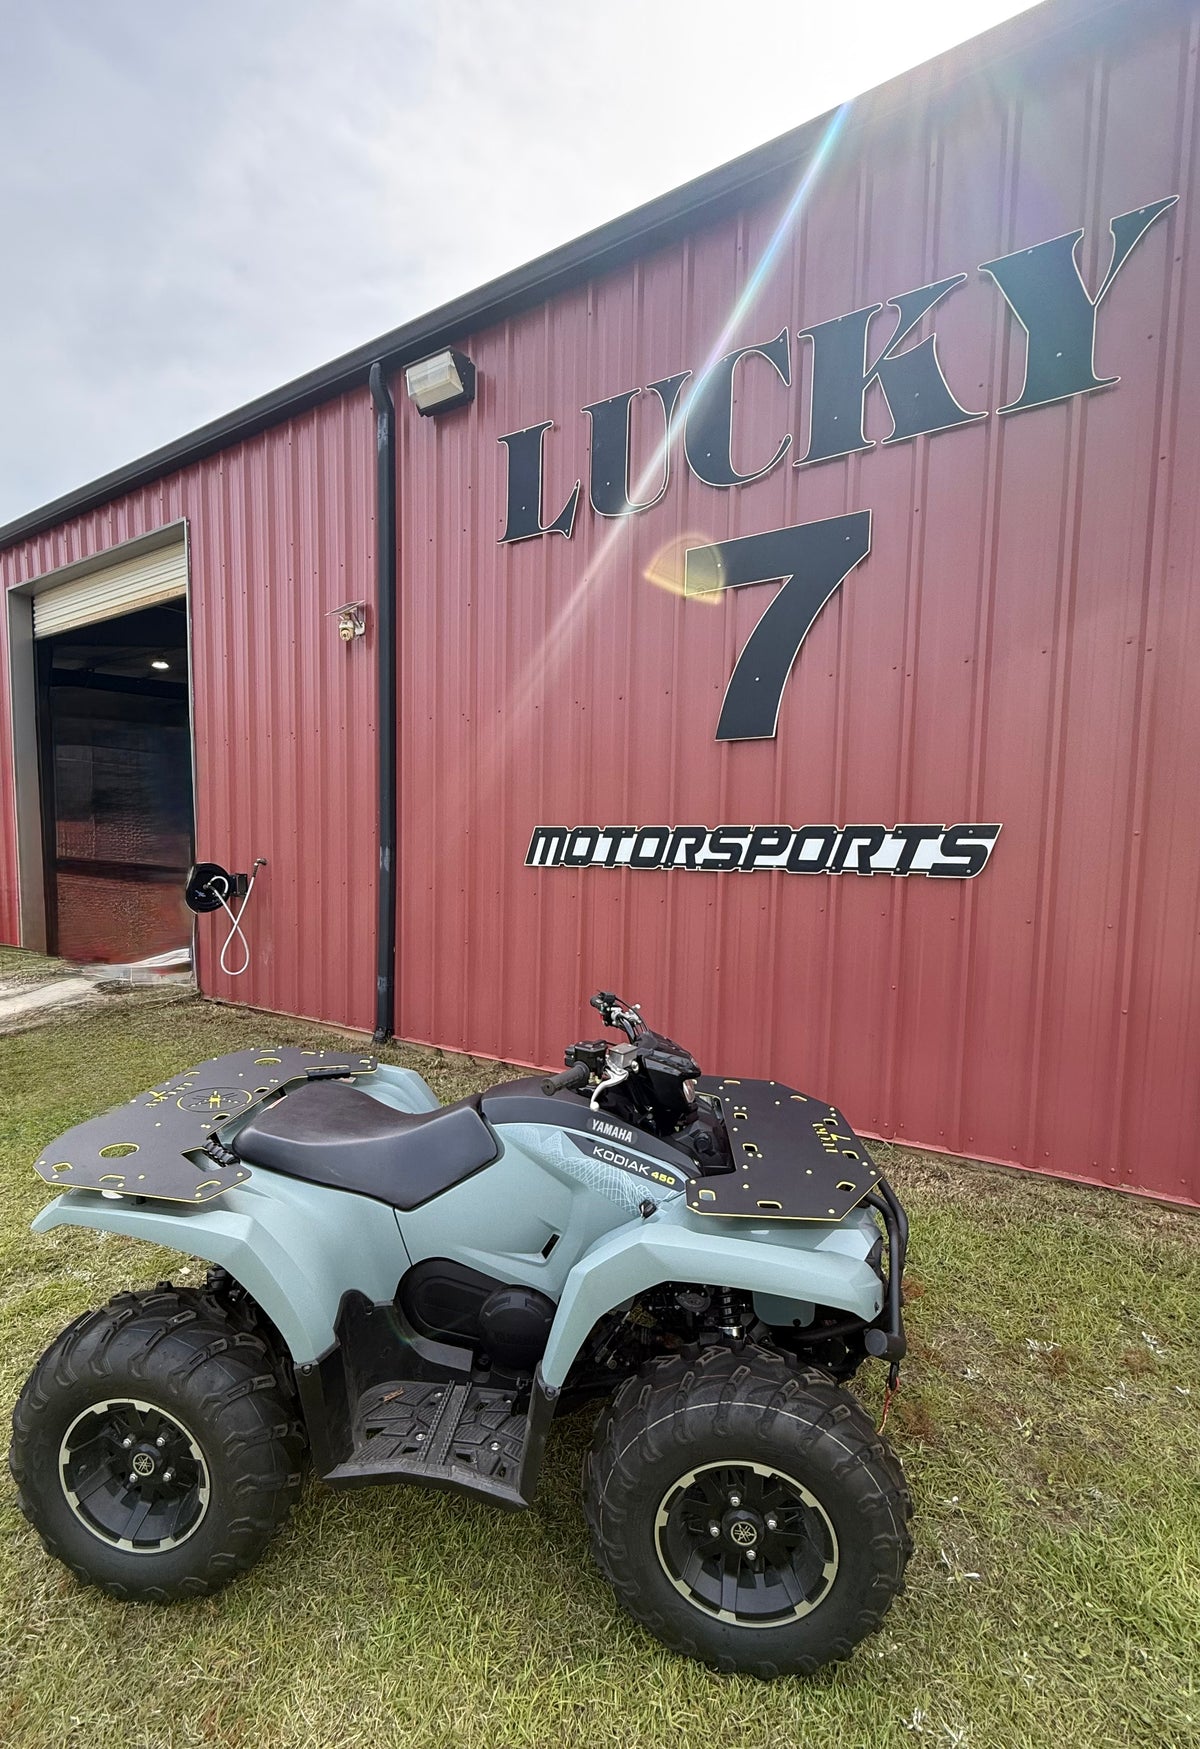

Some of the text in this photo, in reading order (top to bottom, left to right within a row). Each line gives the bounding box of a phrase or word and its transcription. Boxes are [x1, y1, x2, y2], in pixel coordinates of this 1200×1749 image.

[497, 195, 1180, 544] LUCKY
[684, 509, 872, 741] 7
[525, 823, 1003, 879] MOTORSPORTS
[593, 1119, 633, 1143] YAMAHA
[593, 1146, 675, 1185] KODIAK 450
